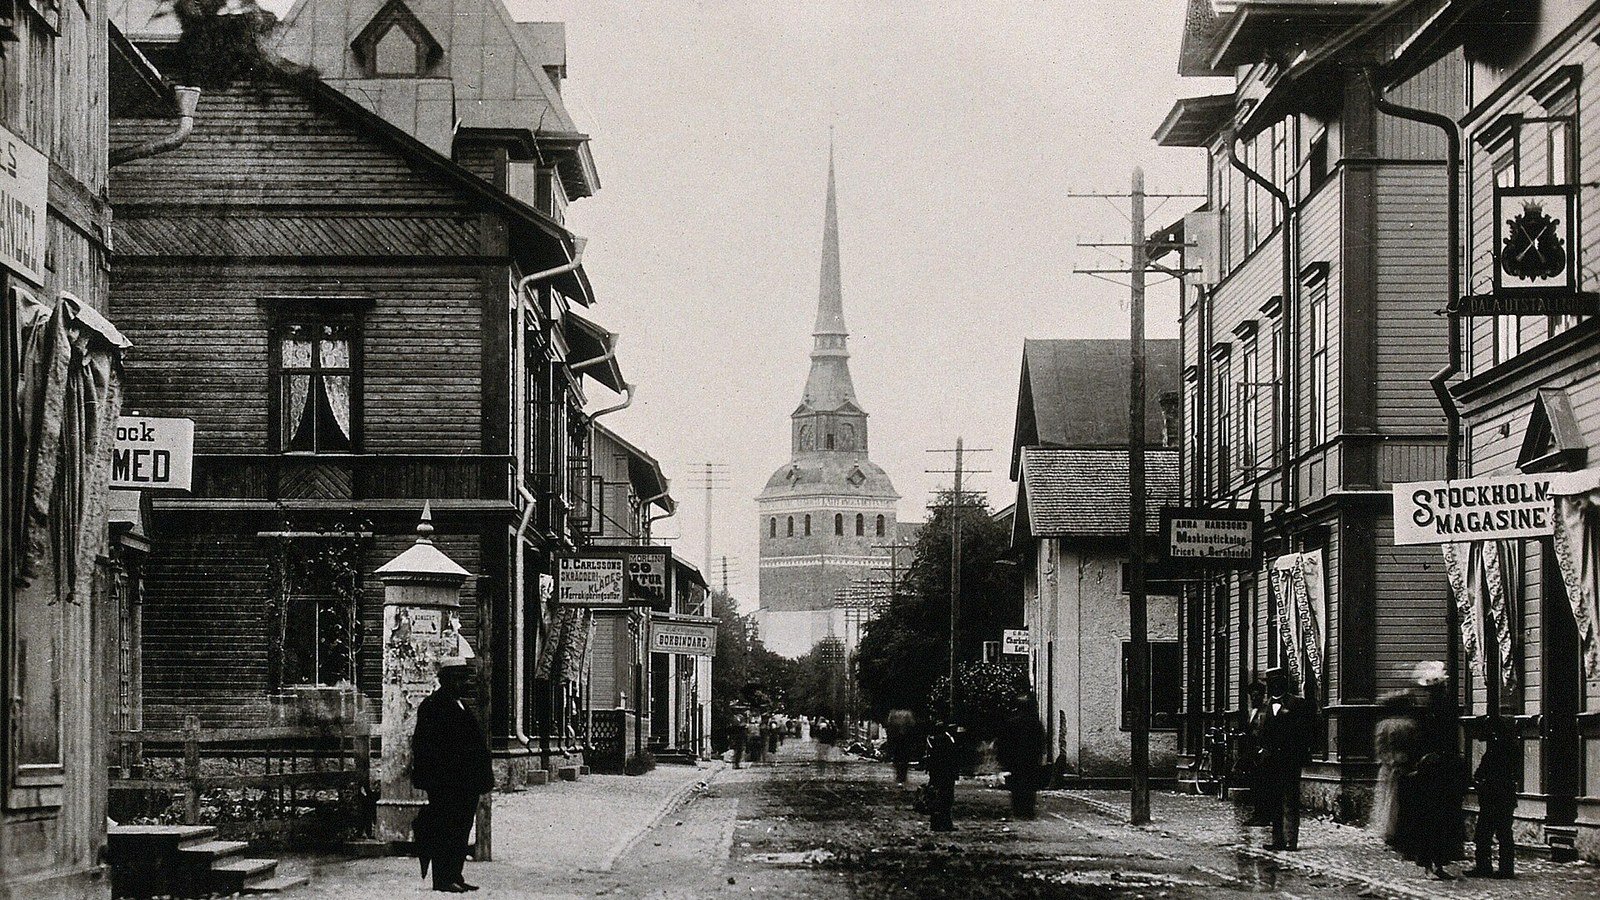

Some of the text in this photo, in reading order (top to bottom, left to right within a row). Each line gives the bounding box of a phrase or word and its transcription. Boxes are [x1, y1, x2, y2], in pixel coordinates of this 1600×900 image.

[116, 421, 155, 442] ock
[112, 448, 171, 483] MED
[1176, 520, 1248, 531] ANNA HANSSONS
[1436, 507, 1552, 535] MAGASINE
[573, 559, 622, 570] CARLSSONS
[659, 635, 708, 648] BOKBINDARE
